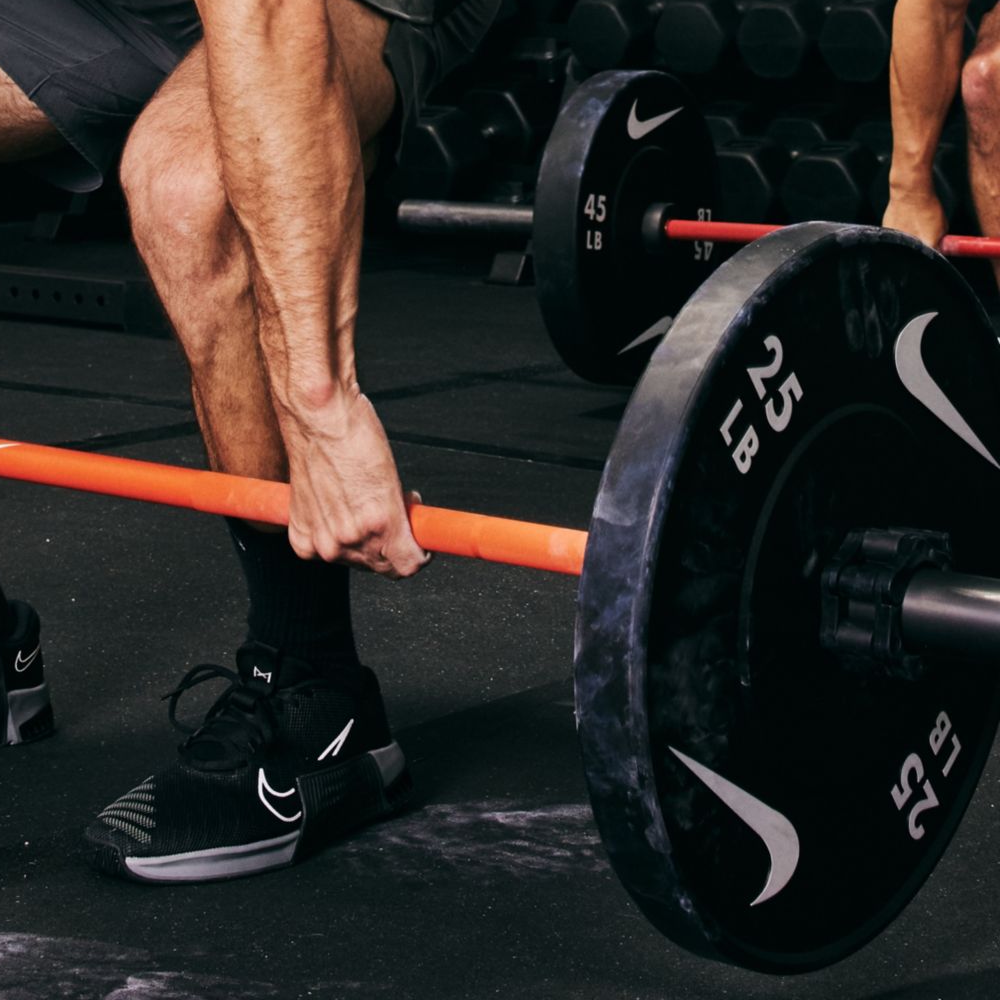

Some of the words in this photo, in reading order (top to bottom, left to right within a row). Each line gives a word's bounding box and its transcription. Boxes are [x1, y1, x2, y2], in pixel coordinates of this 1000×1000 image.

[584, 193, 606, 222] 45
[586, 230, 602, 250] LB
[747, 335, 803, 432] 25
[719, 398, 759, 474] LB
[928, 710, 961, 777] LB
[890, 753, 939, 840] 25
